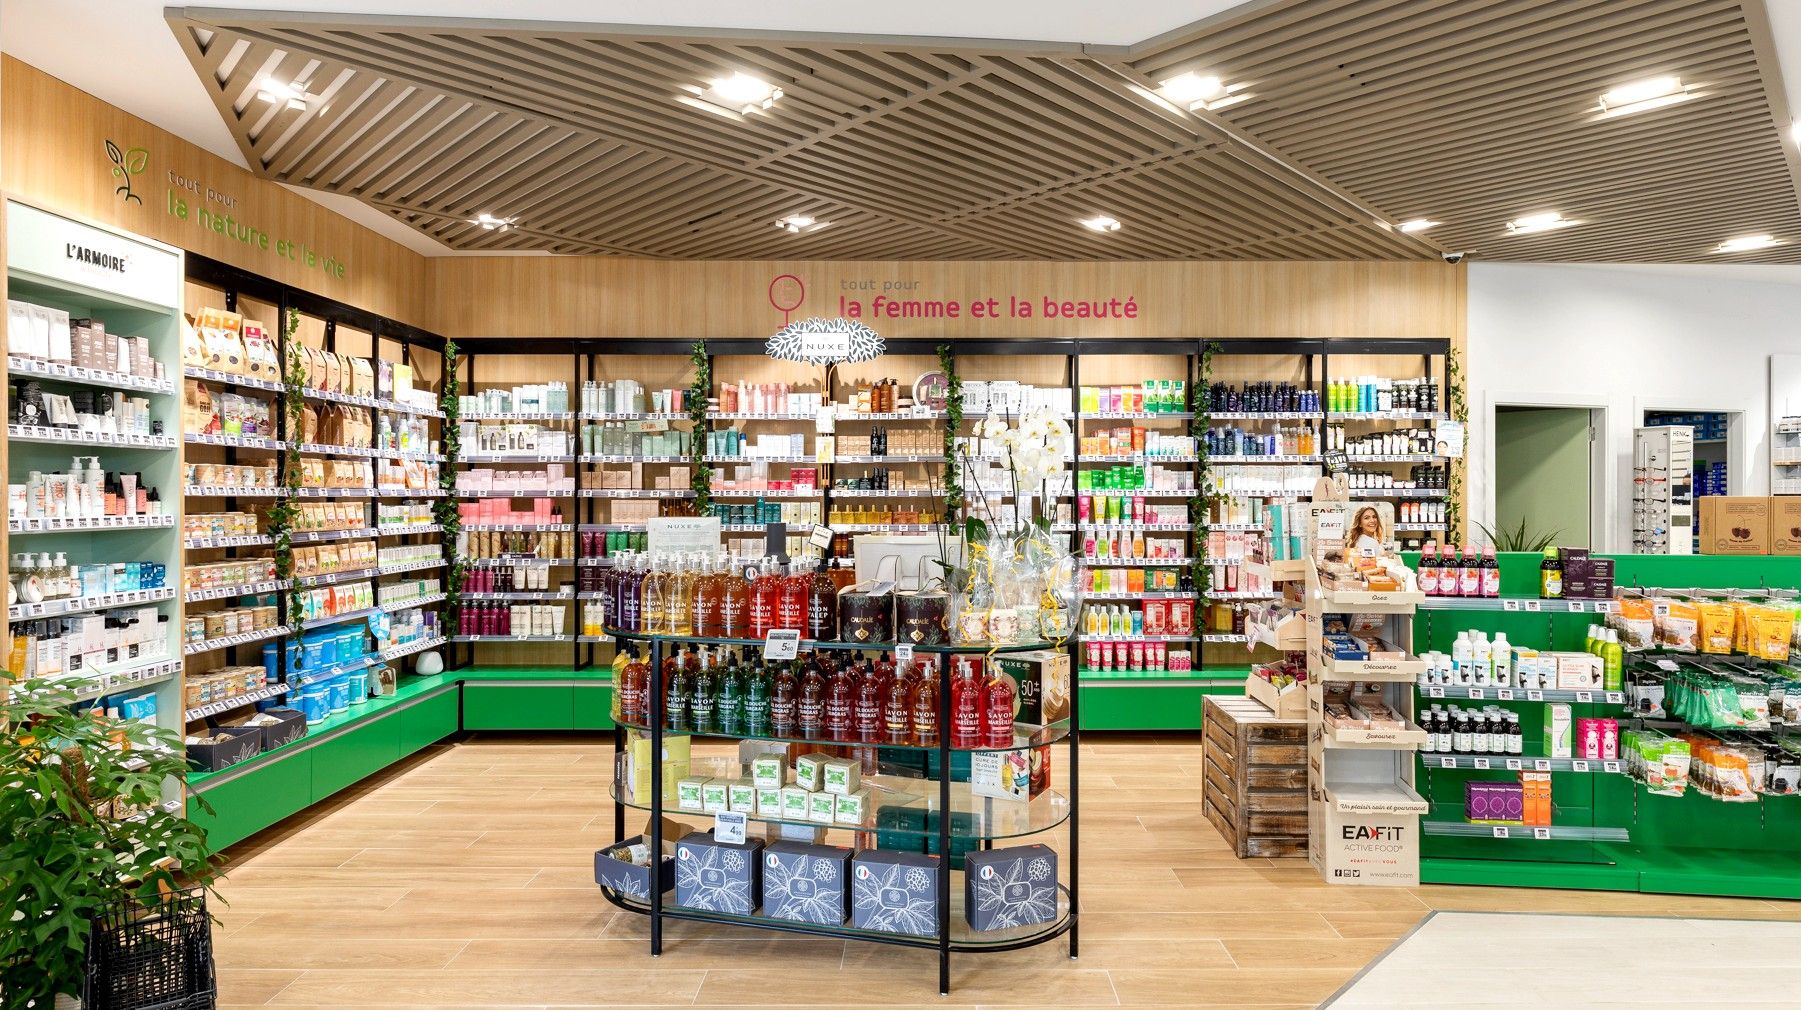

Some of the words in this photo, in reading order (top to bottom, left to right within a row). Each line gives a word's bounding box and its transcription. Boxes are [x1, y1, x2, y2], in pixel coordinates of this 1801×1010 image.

[168, 169, 200, 194] tout
[206, 188, 237, 209] pour
[167, 189, 188, 221] la
[197, 206, 269, 250] nature
[275, 238, 296, 260] et
[302, 242, 317, 268] la
[320, 254, 345, 279] vie
[66, 243, 126, 273] L'ARMOIRE
[840, 279, 876, 290] tout
[883, 279, 920, 293] pour
[839, 295, 862, 318] la
[872, 295, 960, 318] femme
[971, 297, 1000, 318] et
[1010, 295, 1032, 318] la
[1043, 295, 1138, 318] beauté
[806, 342, 845, 351] NUXE
[1344, 844, 1373, 852] ACTIVE
